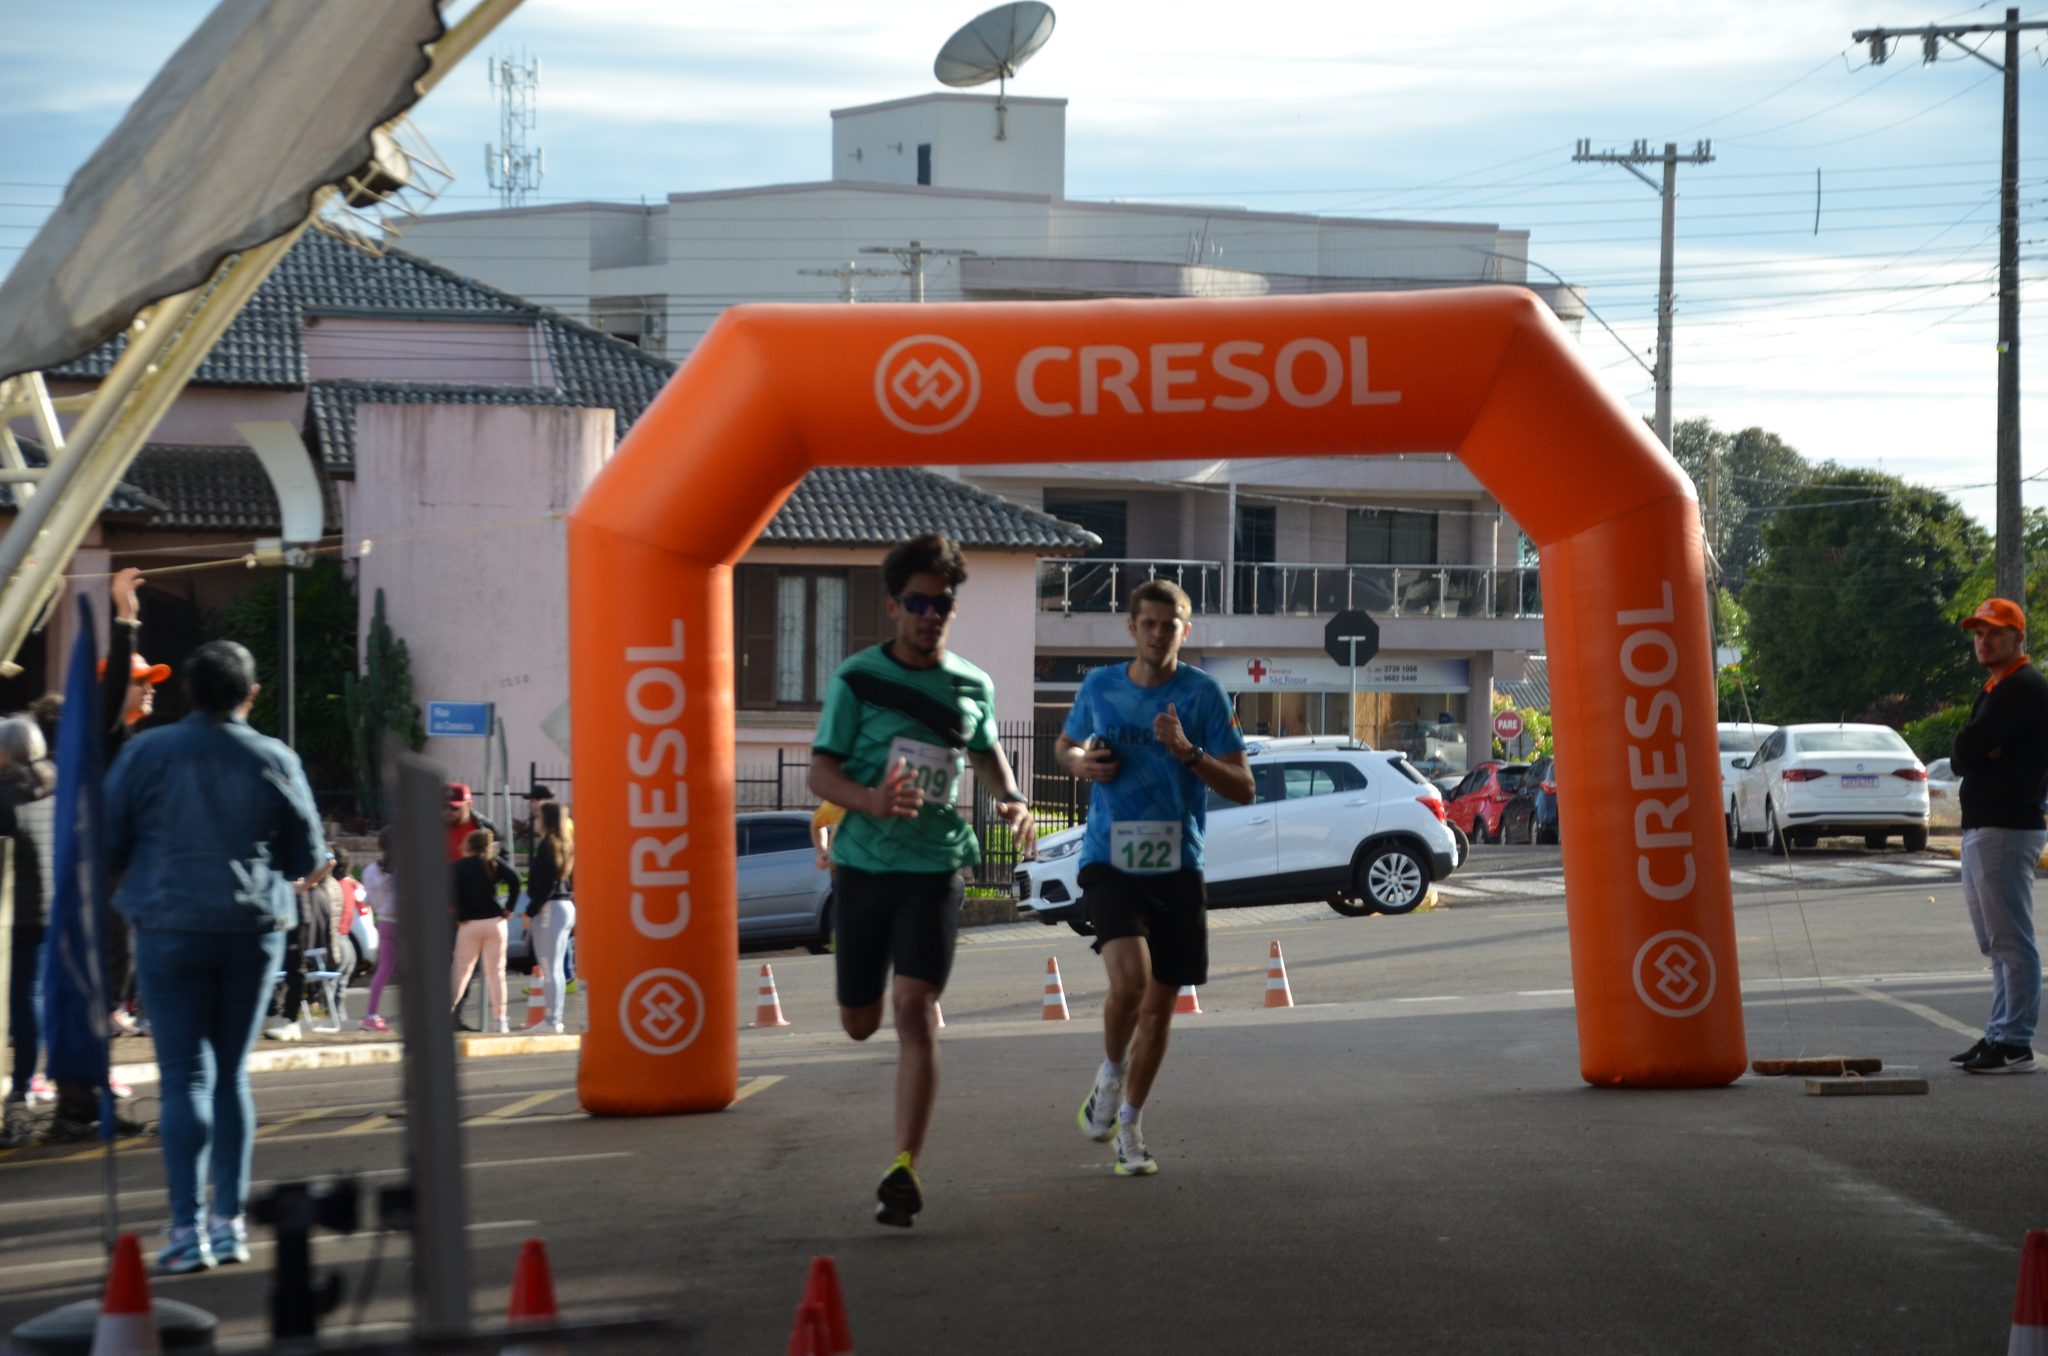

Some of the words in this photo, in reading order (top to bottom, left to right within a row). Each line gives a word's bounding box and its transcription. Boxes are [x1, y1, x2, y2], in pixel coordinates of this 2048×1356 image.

[1015, 336, 1402, 417] CRESOL
[1498, 719, 1518, 730] PARE
[1617, 580, 1696, 900] CRESOL
[625, 618, 691, 939] CRESOL
[1122, 841, 1172, 868] 122
